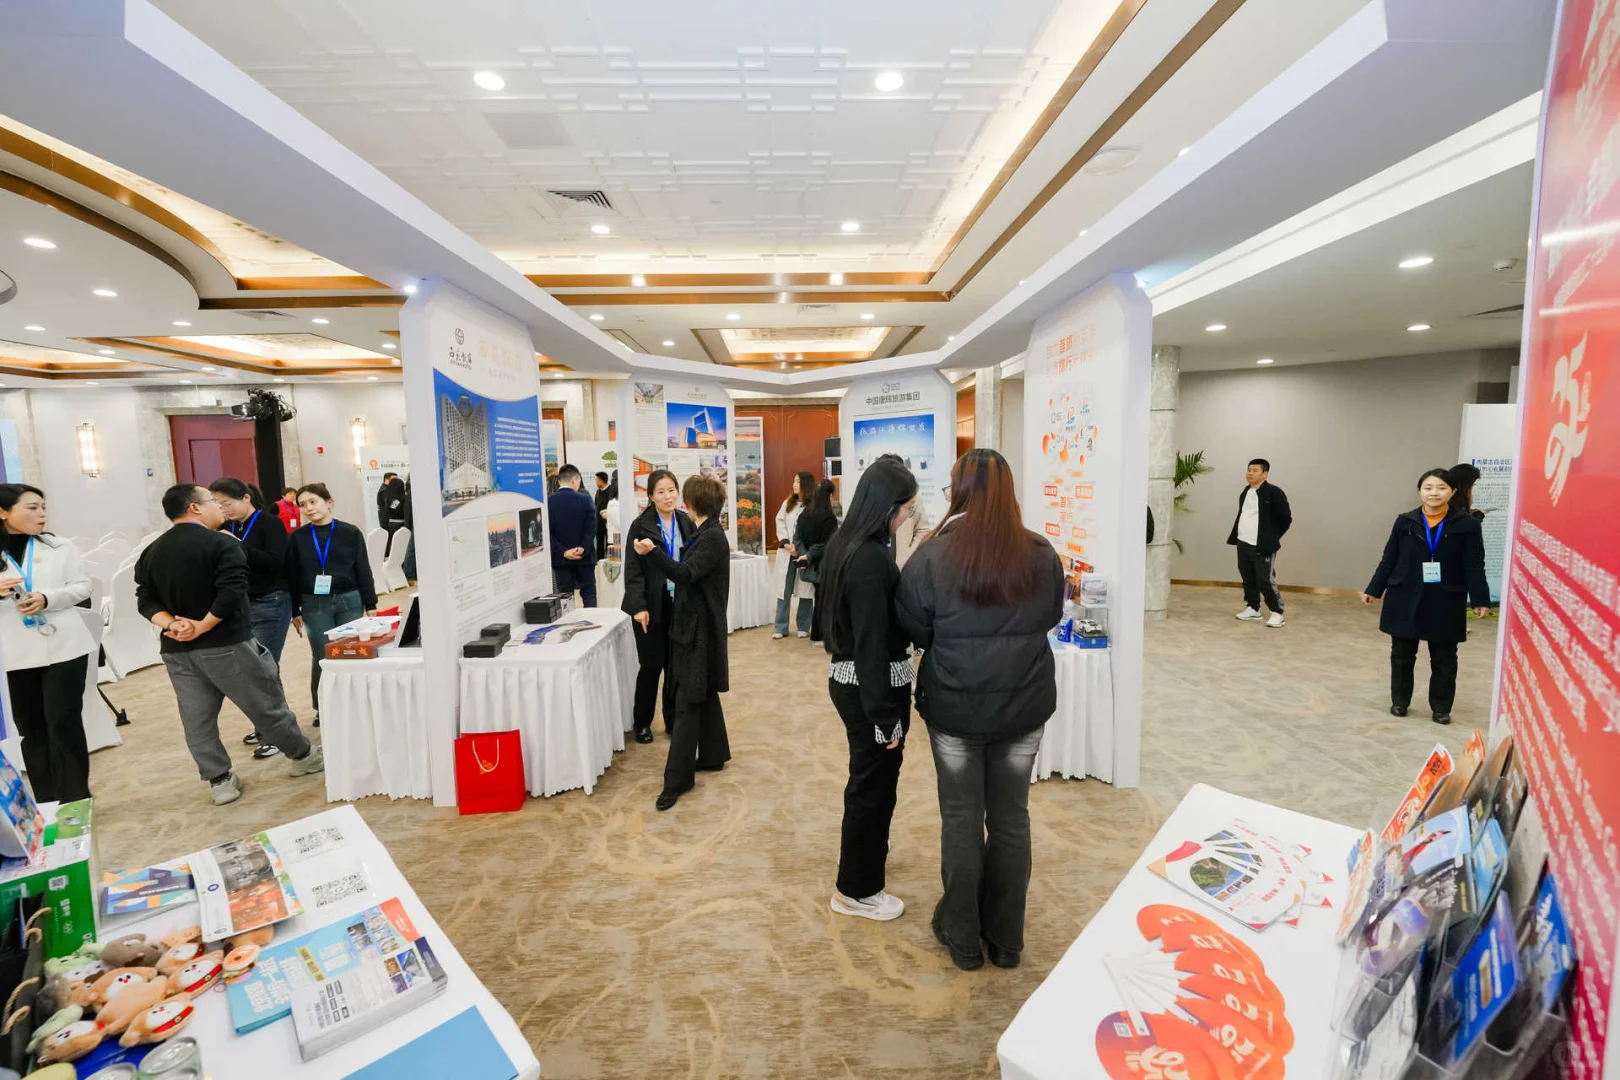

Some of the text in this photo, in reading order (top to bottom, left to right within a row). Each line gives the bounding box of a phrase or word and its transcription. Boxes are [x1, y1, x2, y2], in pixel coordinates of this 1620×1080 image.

[866, 391, 920, 405] 中国康辉旅游集团
